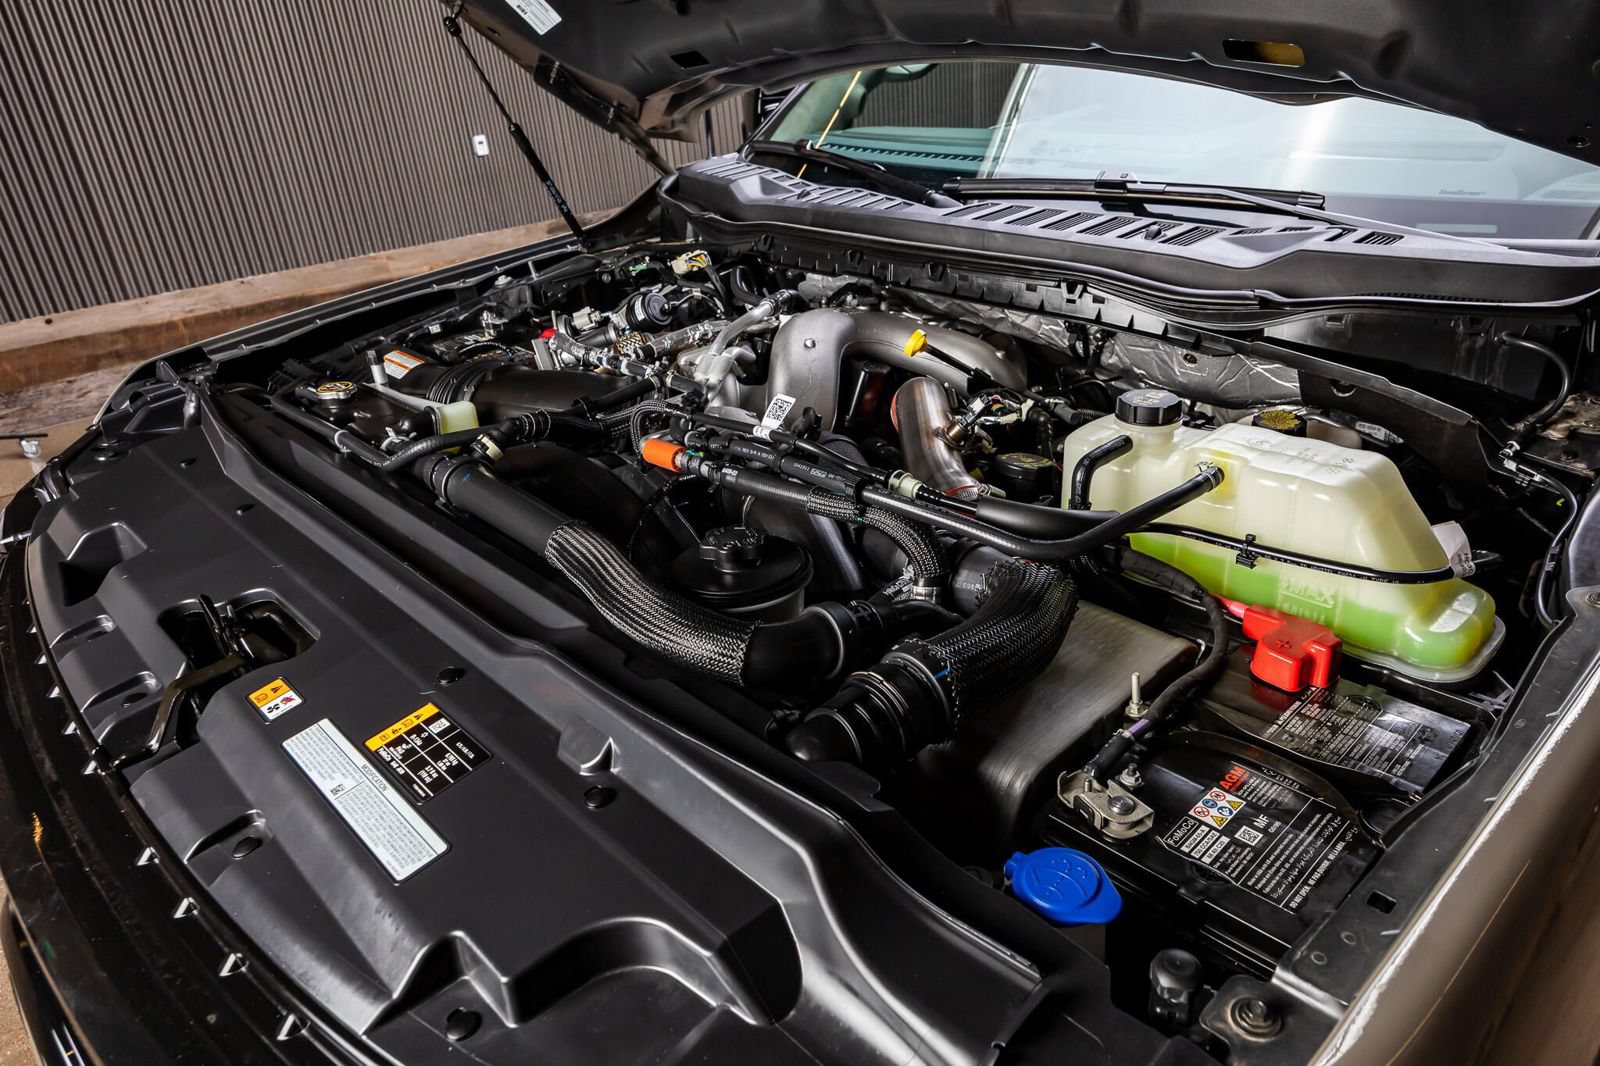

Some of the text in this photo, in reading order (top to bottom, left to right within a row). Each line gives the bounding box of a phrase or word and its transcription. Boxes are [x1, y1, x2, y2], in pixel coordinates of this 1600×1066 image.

[1219, 766, 1248, 790] AGM
[1253, 814, 1269, 828] MF
[1167, 818, 1196, 845] FoMoCo
[1294, 894, 1303, 903] NOT
[1299, 886, 1311, 896] OPEN.
